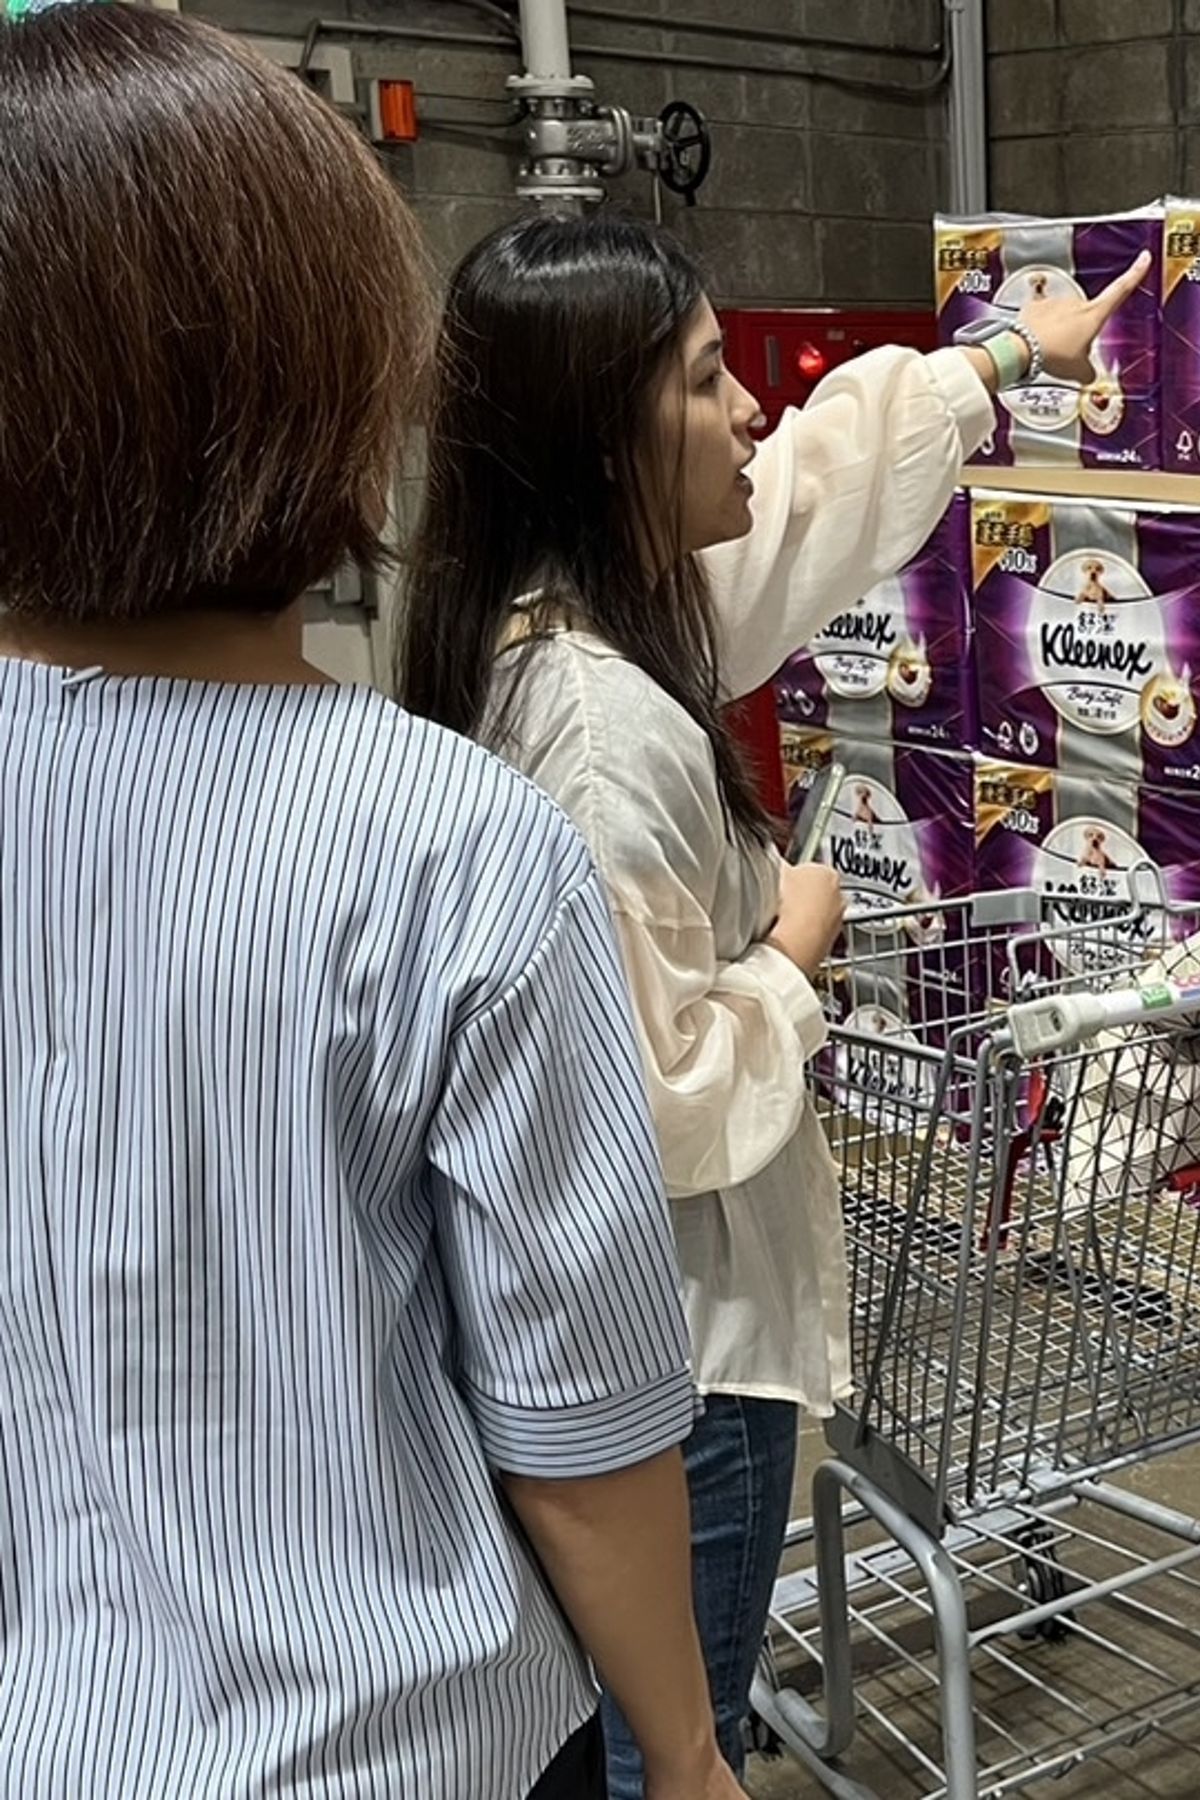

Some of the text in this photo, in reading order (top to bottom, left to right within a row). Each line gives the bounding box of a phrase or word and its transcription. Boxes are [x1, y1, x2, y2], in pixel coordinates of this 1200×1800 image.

[815, 612, 896, 650] eenex
[1041, 623, 1153, 681] Kleenex
[831, 835, 912, 893] Kleenex
